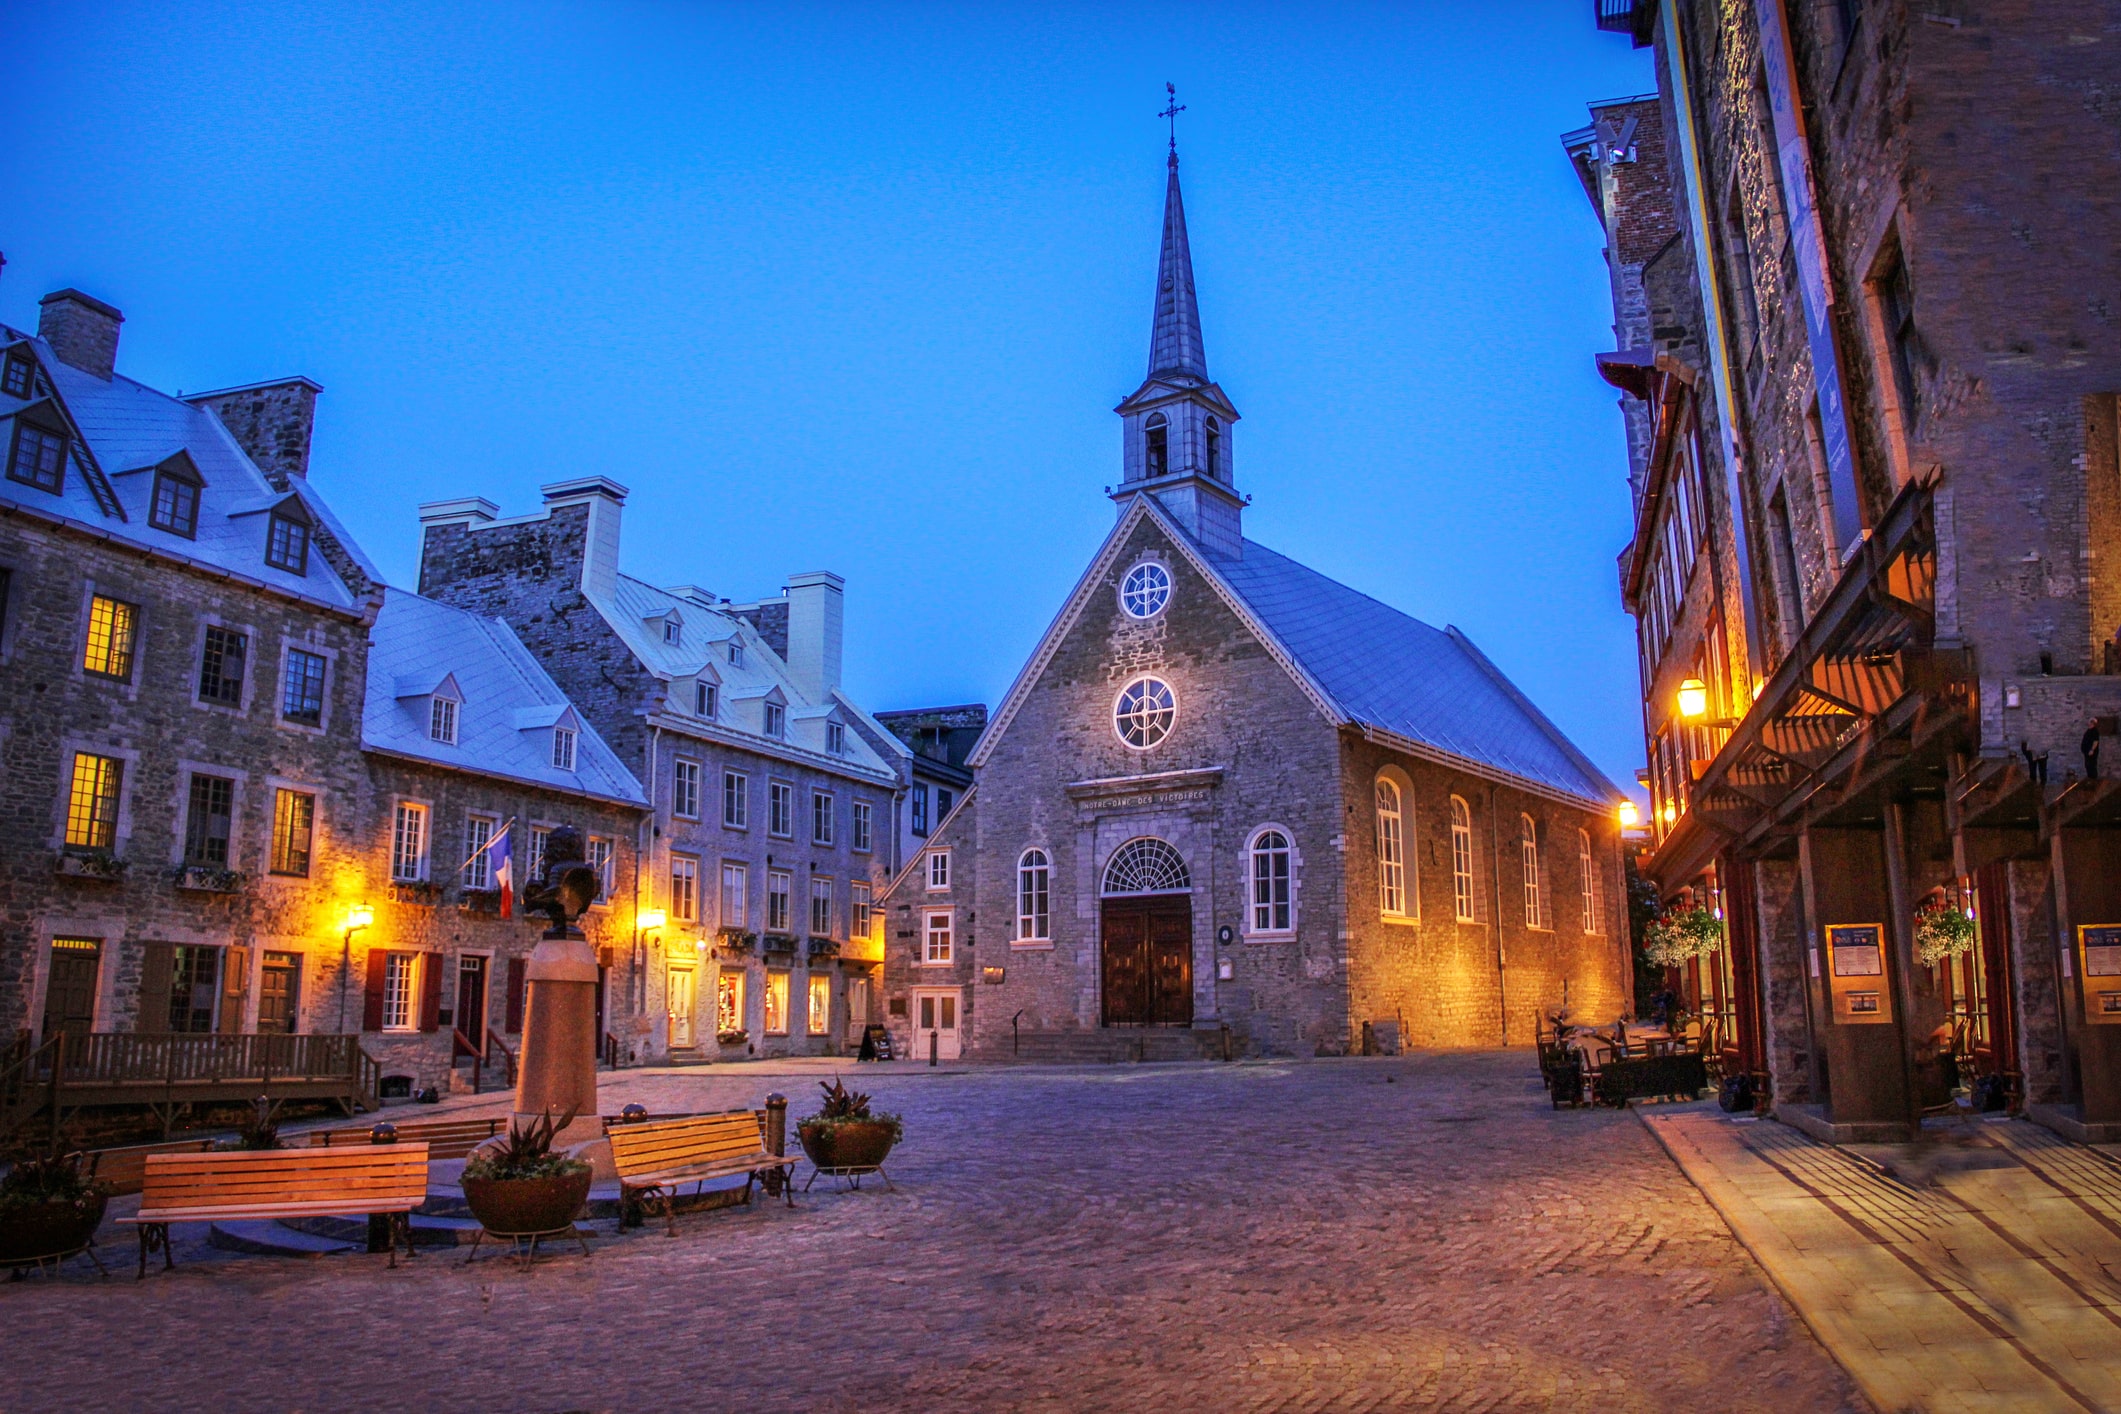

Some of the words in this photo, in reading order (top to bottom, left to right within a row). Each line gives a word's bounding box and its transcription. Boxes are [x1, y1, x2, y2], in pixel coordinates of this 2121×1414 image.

[1085, 798, 1131, 809] NOTRE-DAME
[1138, 796, 1153, 805] DES
[1160, 791, 1204, 802] VICTOIRES
